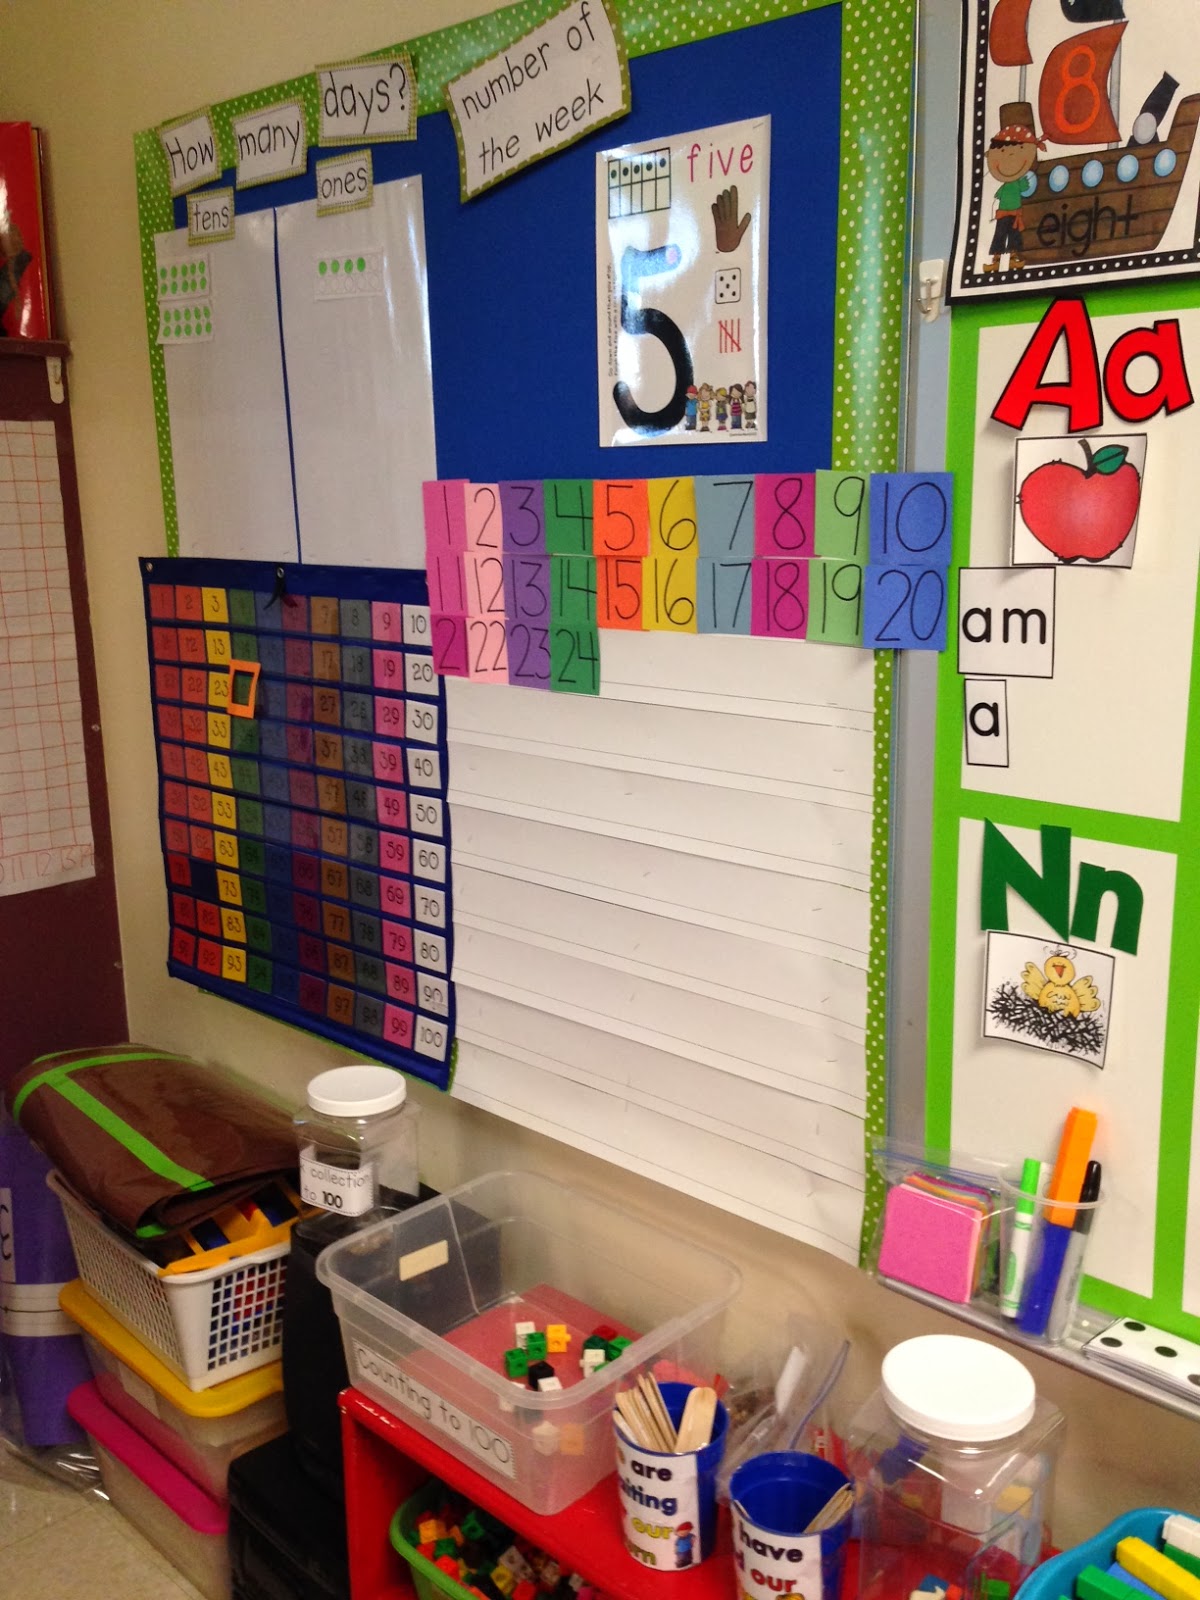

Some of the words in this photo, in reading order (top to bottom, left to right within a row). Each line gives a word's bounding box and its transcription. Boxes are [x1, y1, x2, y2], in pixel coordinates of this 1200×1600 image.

[462, 42, 550, 120] number
[566, 0, 595, 52] of
[1055, 44, 1100, 134] 8
[165, 136, 214, 178] How
[237, 120, 300, 165] many
[324, 62, 407, 133] days?
[479, 135, 521, 175] the
[535, 78, 604, 143] week
[321, 167, 367, 199] ones
[686, 143, 754, 183] five
[193, 203, 229, 231] tens
[1036, 194, 1139, 257] eight
[613, 243, 693, 437] 5
[991, 294, 1195, 434] Aa
[442, 484, 452, 546] 1
[474, 487, 498, 548] 2
[509, 486, 541, 547] 3
[554, 484, 595, 551] 4
[604, 484, 635, 551] 5
[659, 480, 696, 551] 6
[712, 480, 754, 551] 7
[772, 477, 806, 550] 8
[834, 476, 865, 556] 9
[883, 481, 947, 554] 10
[184, 594, 194, 611] 2
[211, 594, 221, 613] 3
[351, 607, 361, 627] 8
[381, 611, 393, 631] 9
[411, 614, 427, 635] 10
[436, 556, 464, 611] 11
[474, 557, 505, 614] 12
[511, 559, 547, 619] 13
[559, 558, 598, 621] 14
[606, 557, 641, 620] 15
[654, 557, 695, 626] 16
[711, 562, 752, 629] 17
[766, 561, 806, 632] 18
[822, 562, 862, 636] 19
[875, 569, 944, 642] 20
[962, 607, 1047, 645] am
[185, 636, 199, 653] 12
[212, 638, 227, 656] 13
[320, 650, 334, 670] 17
[351, 654, 365, 673] 18
[382, 657, 397, 678] 19
[411, 661, 434, 683] 20
[470, 620, 507, 673] 22
[510, 623, 551, 681] 23
[555, 628, 599, 690] 24
[187, 676, 204, 694] 22
[213, 679, 230, 698] 23
[319, 694, 336, 715] 27
[382, 705, 400, 725] 29
[411, 709, 434, 731] 30
[969, 702, 1000, 737] a
[211, 719, 228, 739] 33
[379, 749, 398, 772] 39
[413, 757, 434, 778] 40
[212, 761, 229, 780] 43
[383, 798, 401, 817] 49
[414, 803, 438, 825] 50
[36, 852, 52, 877] 12
[216, 800, 233, 819] 53
[326, 825, 344, 845] 57
[385, 840, 405, 862] 59
[417, 850, 441, 871] 60
[219, 841, 235, 859] 63
[326, 868, 344, 889] 67
[355, 877, 374, 898] 68
[385, 885, 405, 906] 69
[418, 896, 440, 919] 70
[980, 816, 1144, 956] Nn
[222, 879, 239, 899] 73
[328, 911, 345, 931] 77
[388, 930, 408, 953] 79
[419, 943, 441, 964] 80
[225, 915, 243, 933] 83
[332, 951, 350, 971] 87
[391, 974, 410, 995] 89
[422, 983, 444, 1005] 90
[226, 953, 243, 973] 93
[333, 994, 351, 1014] 97
[390, 1016, 409, 1037] 99
[418, 1024, 444, 1049] 100
[303, 1185, 317, 1201] to
[322, 1190, 343, 1209] 100
[357, 1347, 432, 1421] Counting
[439, 1400, 461, 1431] to
[468, 1419, 510, 1464] 100
[630, 1460, 673, 1482] are
[631, 1517, 673, 1540] our
[739, 1520, 803, 1563] have
[751, 1568, 797, 1593] our
